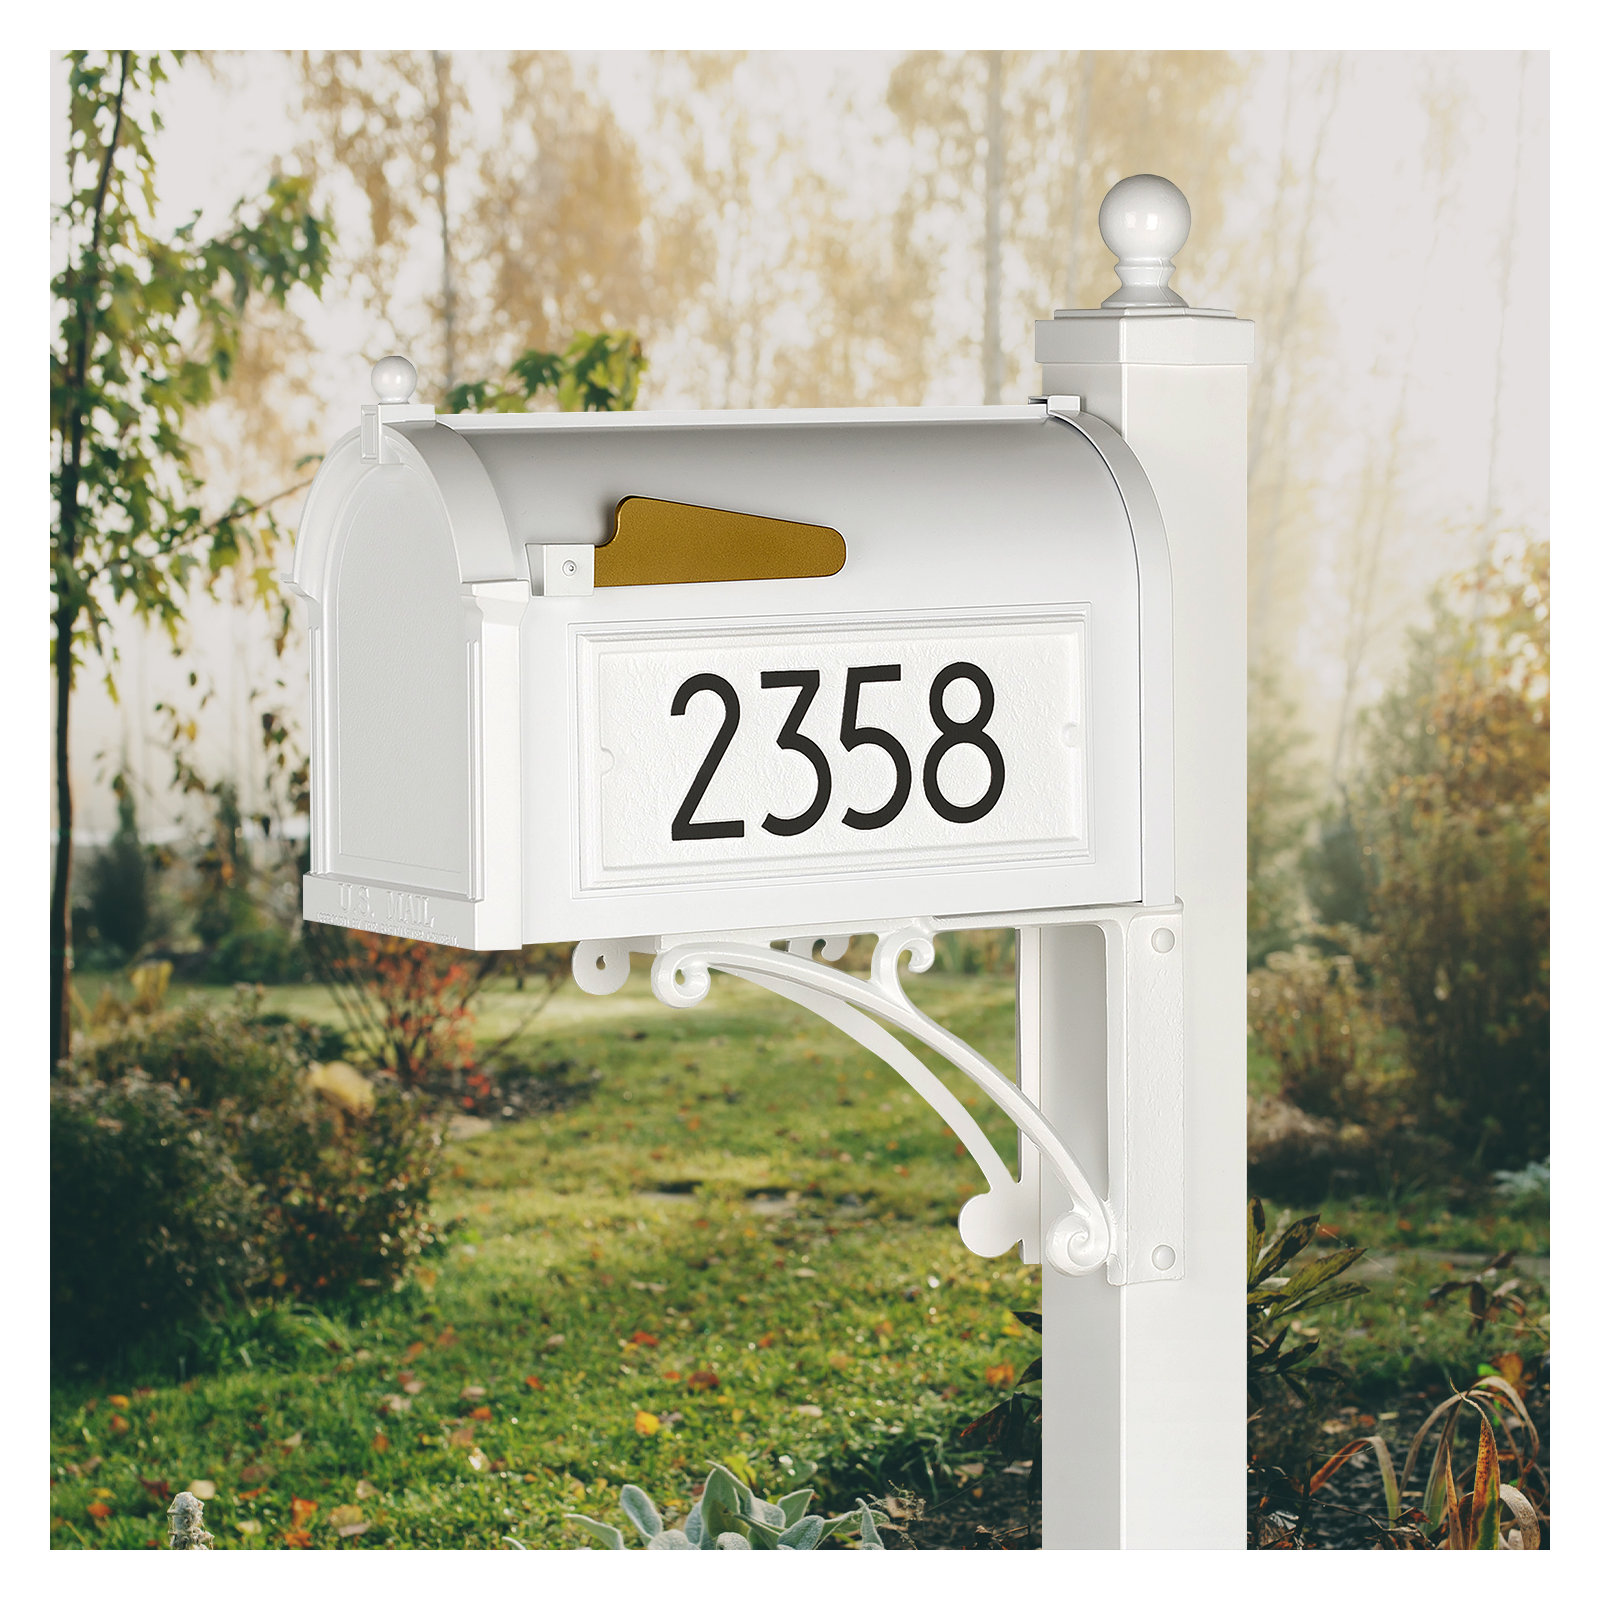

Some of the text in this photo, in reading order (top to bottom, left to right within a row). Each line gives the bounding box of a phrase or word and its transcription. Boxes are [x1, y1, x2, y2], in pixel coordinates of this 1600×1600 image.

[671, 662, 1005, 841] 2358
[337, 882, 436, 929] U.S. MAIL
